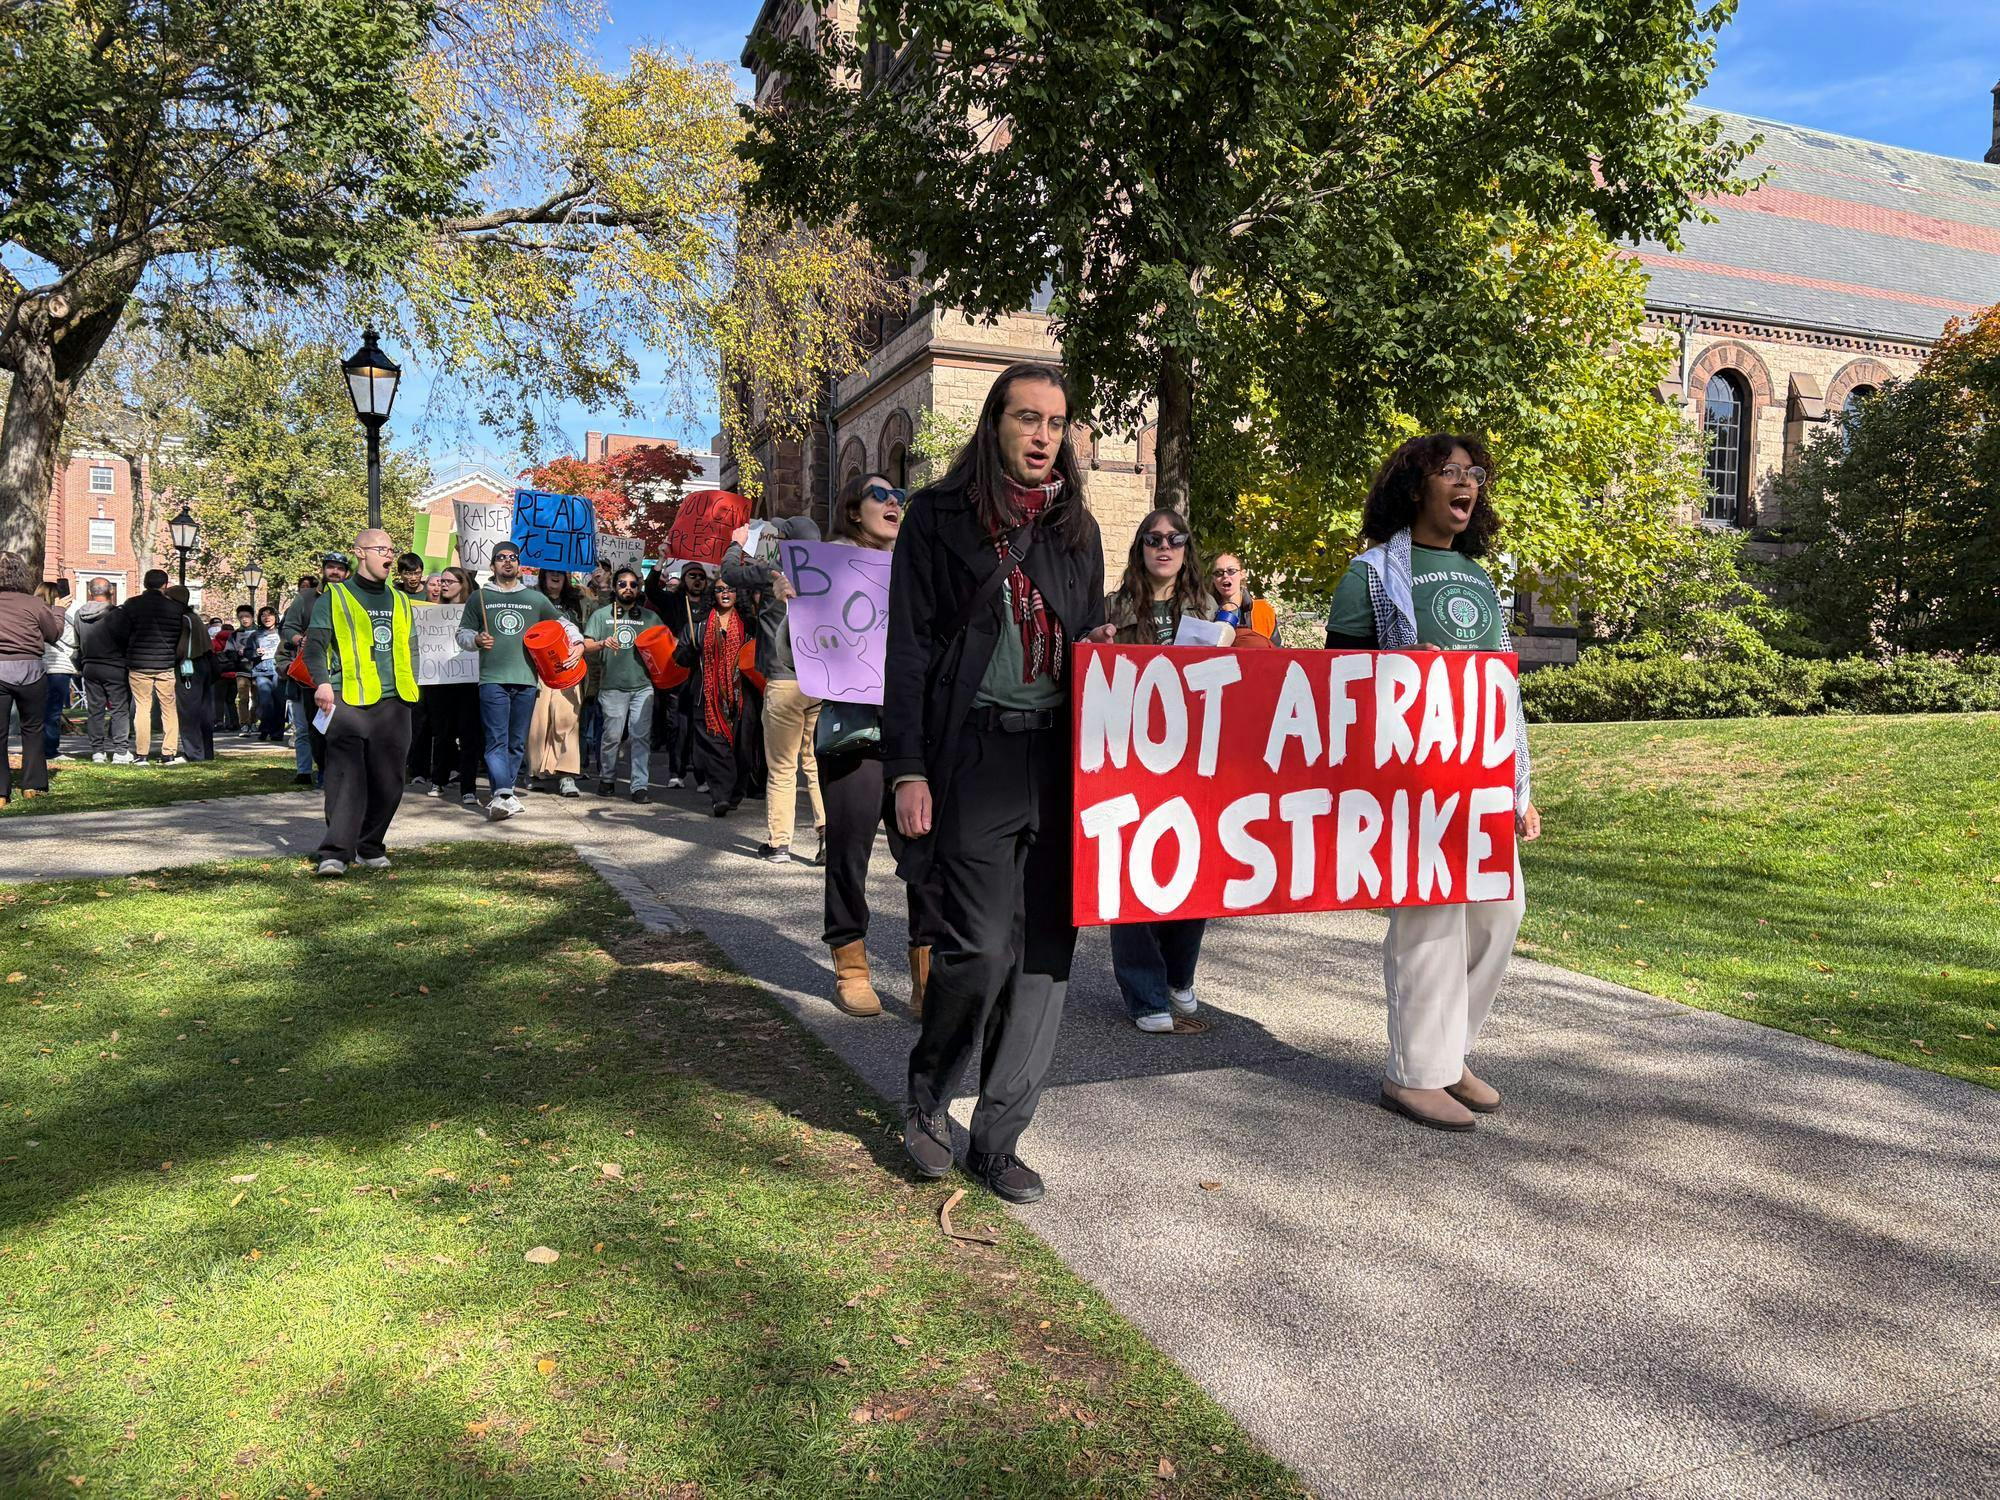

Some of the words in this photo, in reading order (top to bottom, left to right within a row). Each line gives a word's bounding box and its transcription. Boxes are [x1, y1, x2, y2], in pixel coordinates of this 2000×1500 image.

[463, 504, 511, 534] RAISE?
[516, 493, 593, 533] READY
[693, 518, 732, 536] EAT
[518, 530, 543, 559] to
[601, 535, 643, 551] RATHER
[610, 550, 624, 559] AT
[1445, 588, 1461, 597] LABOR
[1456, 628, 1476, 639] GLO
[1080, 649, 1242, 778] NOT
[1263, 652, 1516, 774] AFRAID
[1080, 793, 1201, 921] TO
[1218, 786, 1515, 909] STRIKE
